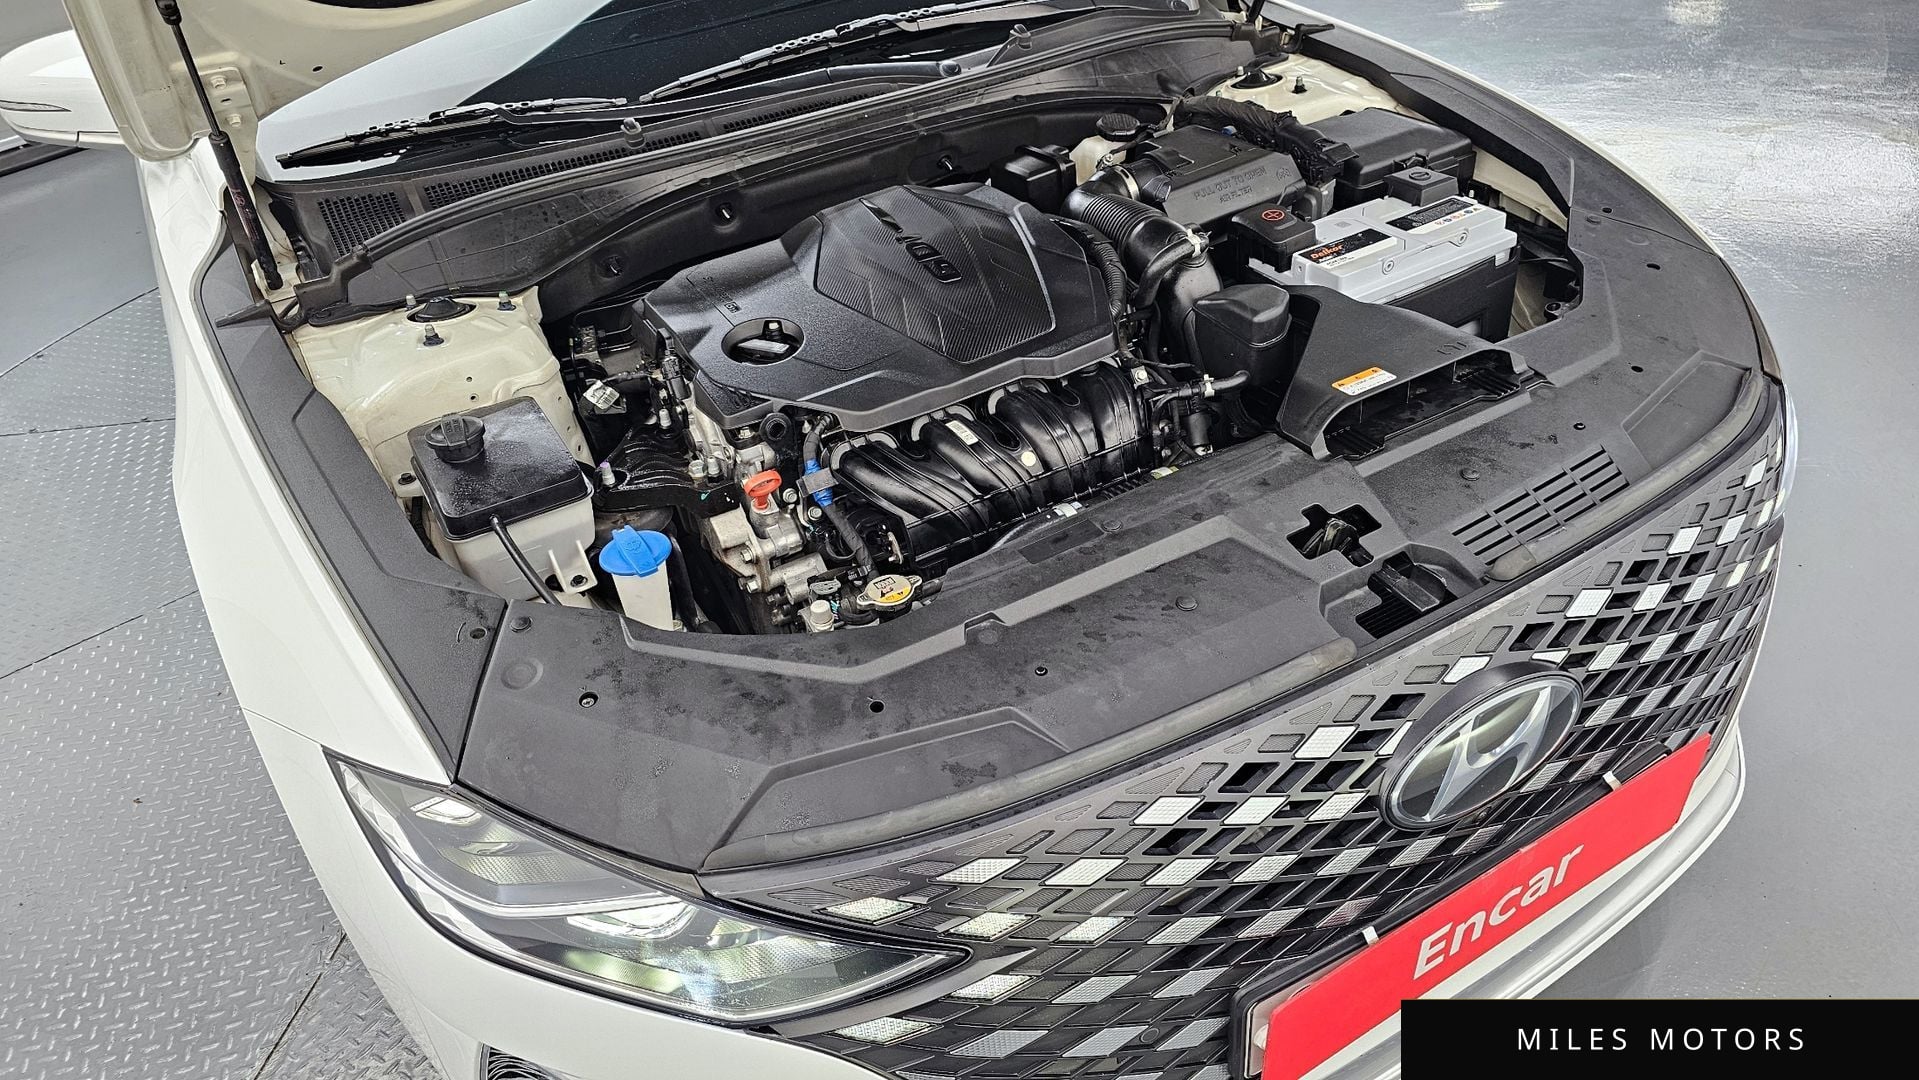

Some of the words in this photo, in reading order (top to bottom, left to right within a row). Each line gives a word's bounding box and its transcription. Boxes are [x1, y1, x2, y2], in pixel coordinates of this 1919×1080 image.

[1194, 187, 1216, 200] PULL
[1216, 180, 1231, 192] OUT
[1231, 174, 1245, 185] TO
[1245, 166, 1267, 180] OPEN
[1412, 844, 1585, 981] Encar
